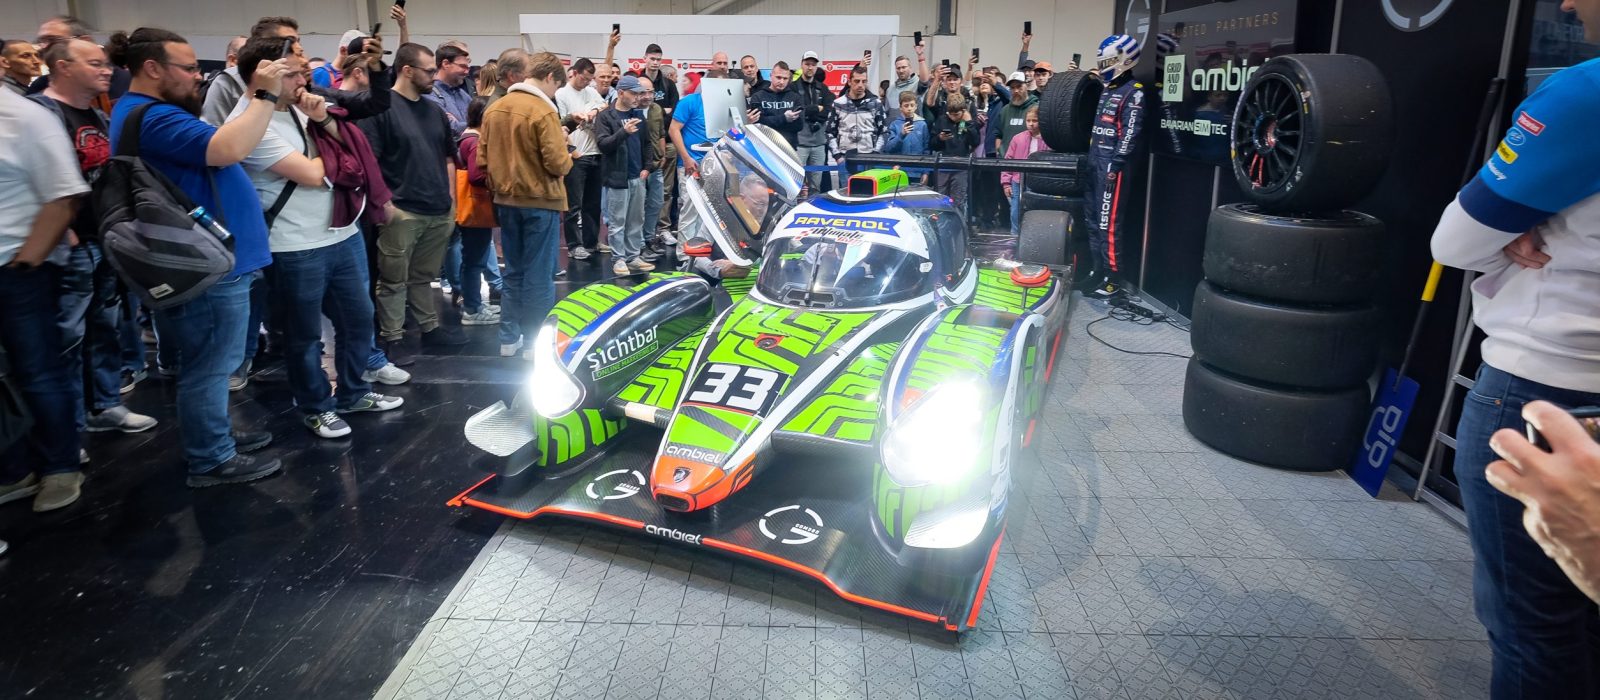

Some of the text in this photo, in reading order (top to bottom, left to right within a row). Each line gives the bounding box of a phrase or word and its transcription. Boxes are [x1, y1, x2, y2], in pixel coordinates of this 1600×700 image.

[1216, 12, 1279, 31] PARTNERS
[1191, 58, 1269, 91] ambi
[794, 216, 890, 231] RAVENOL
[1099, 191, 1112, 230] itstore
[586, 324, 659, 371] sichtbar
[689, 363, 779, 411] 33
[665, 445, 723, 465] ambiel
[645, 523, 702, 545] ambiel
